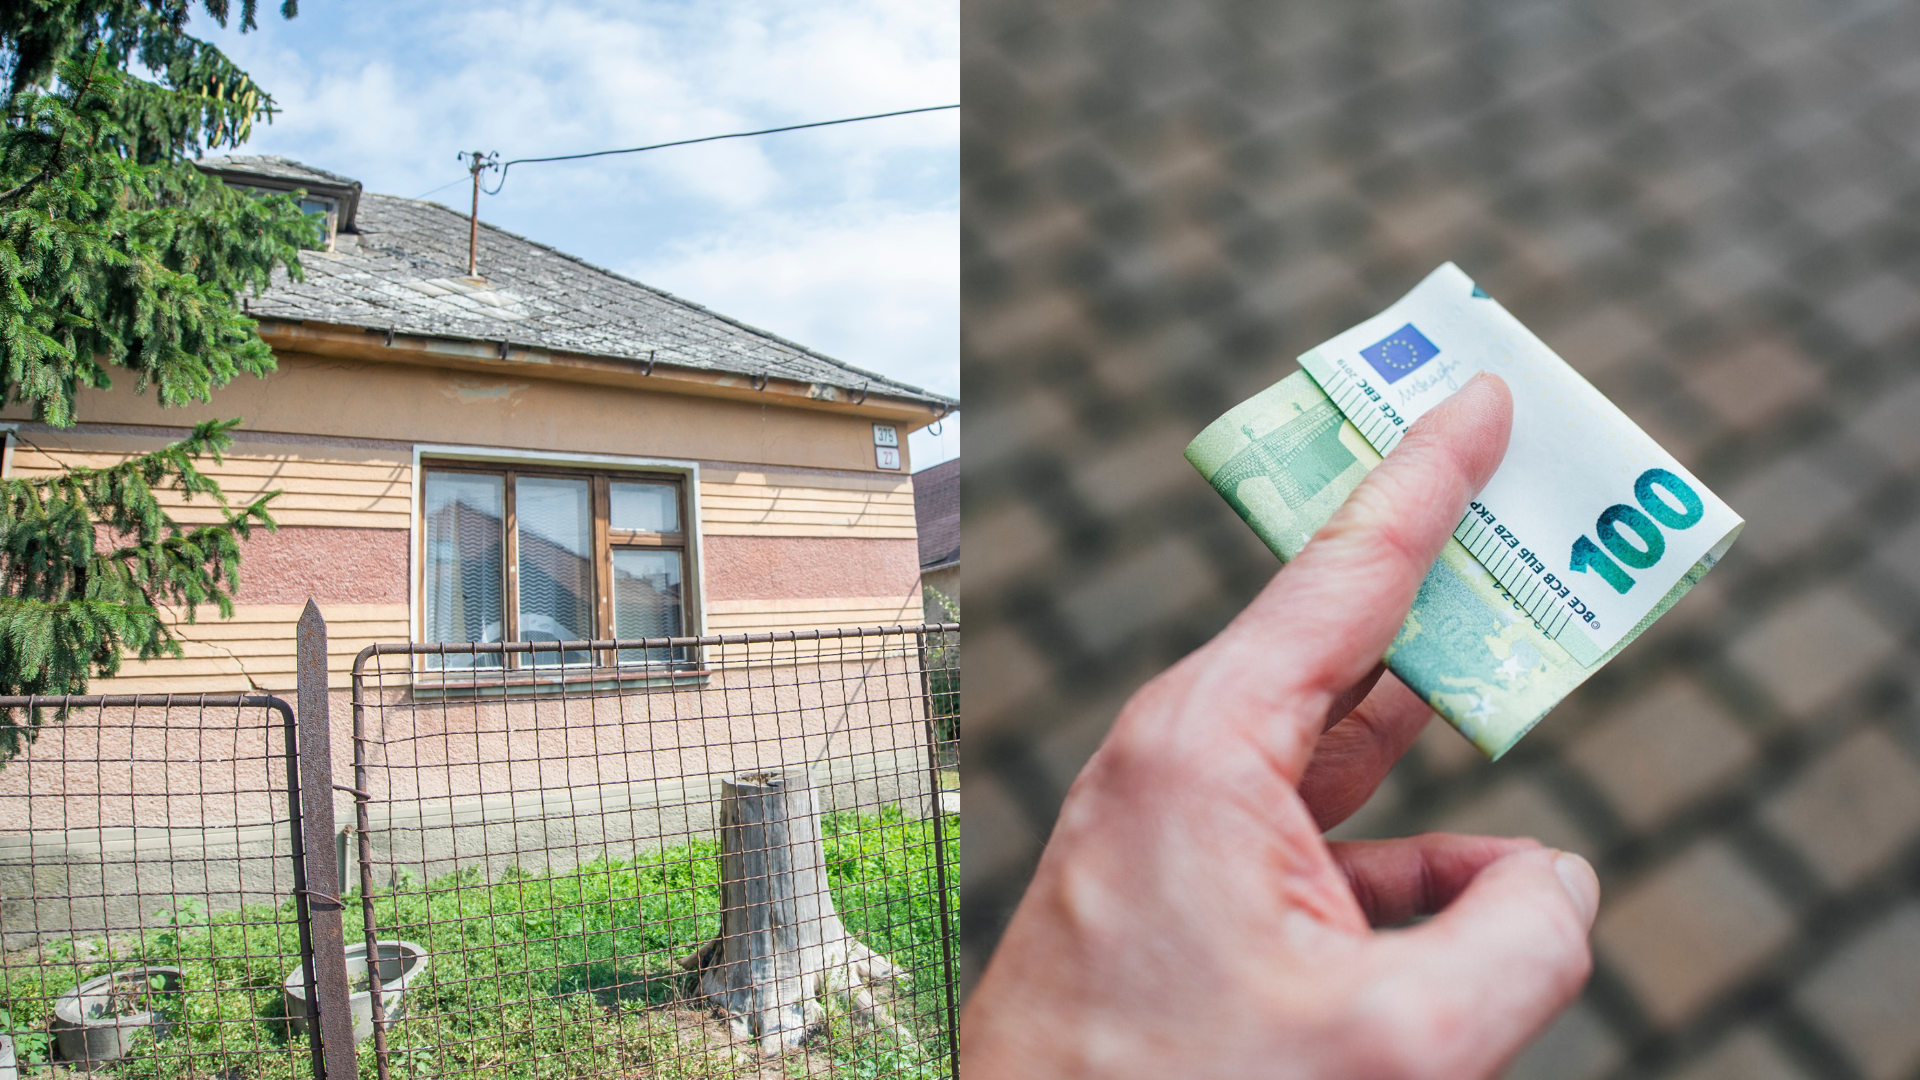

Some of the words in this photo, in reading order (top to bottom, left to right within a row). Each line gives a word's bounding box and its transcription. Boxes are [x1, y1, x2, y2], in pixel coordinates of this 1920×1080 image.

[1337, 358, 1358, 378] 2019
[1356, 378, 1382, 402] EBC
[878, 427, 893, 443] 375
[883, 451, 893, 465] 27
[1470, 501, 1496, 525] EKP
[1494, 524, 1520, 549] EZB
[1569, 468, 1704, 595] 100
[1517, 547, 1546, 575] ЕЦБ
[1543, 573, 1571, 599] ECB
